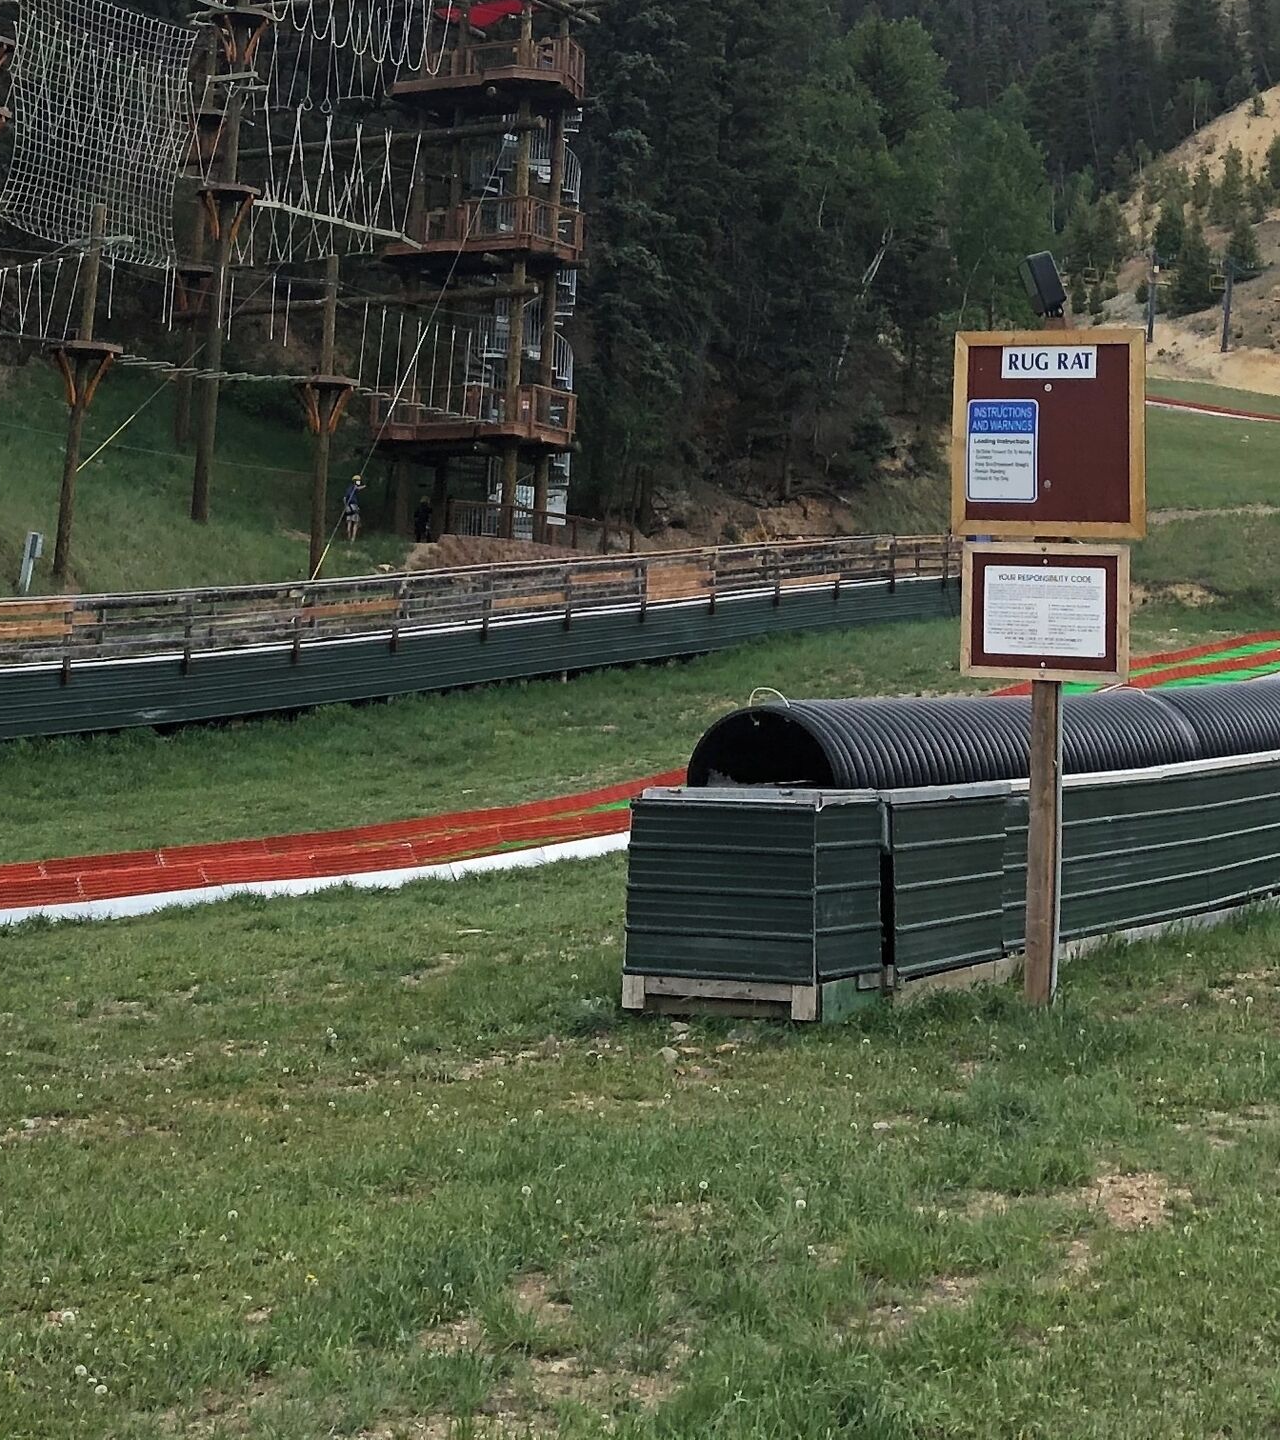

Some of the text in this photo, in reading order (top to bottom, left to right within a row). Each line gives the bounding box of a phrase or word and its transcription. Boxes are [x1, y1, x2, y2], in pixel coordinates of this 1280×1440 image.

[1008, 352, 1093, 371] RUG RAT
[973, 407, 1033, 418] INSTRUCTIONS
[972, 420, 1033, 431] AND WARNINGS
[998, 573, 1092, 583] YOUR RESPONSIBILITY CODE
